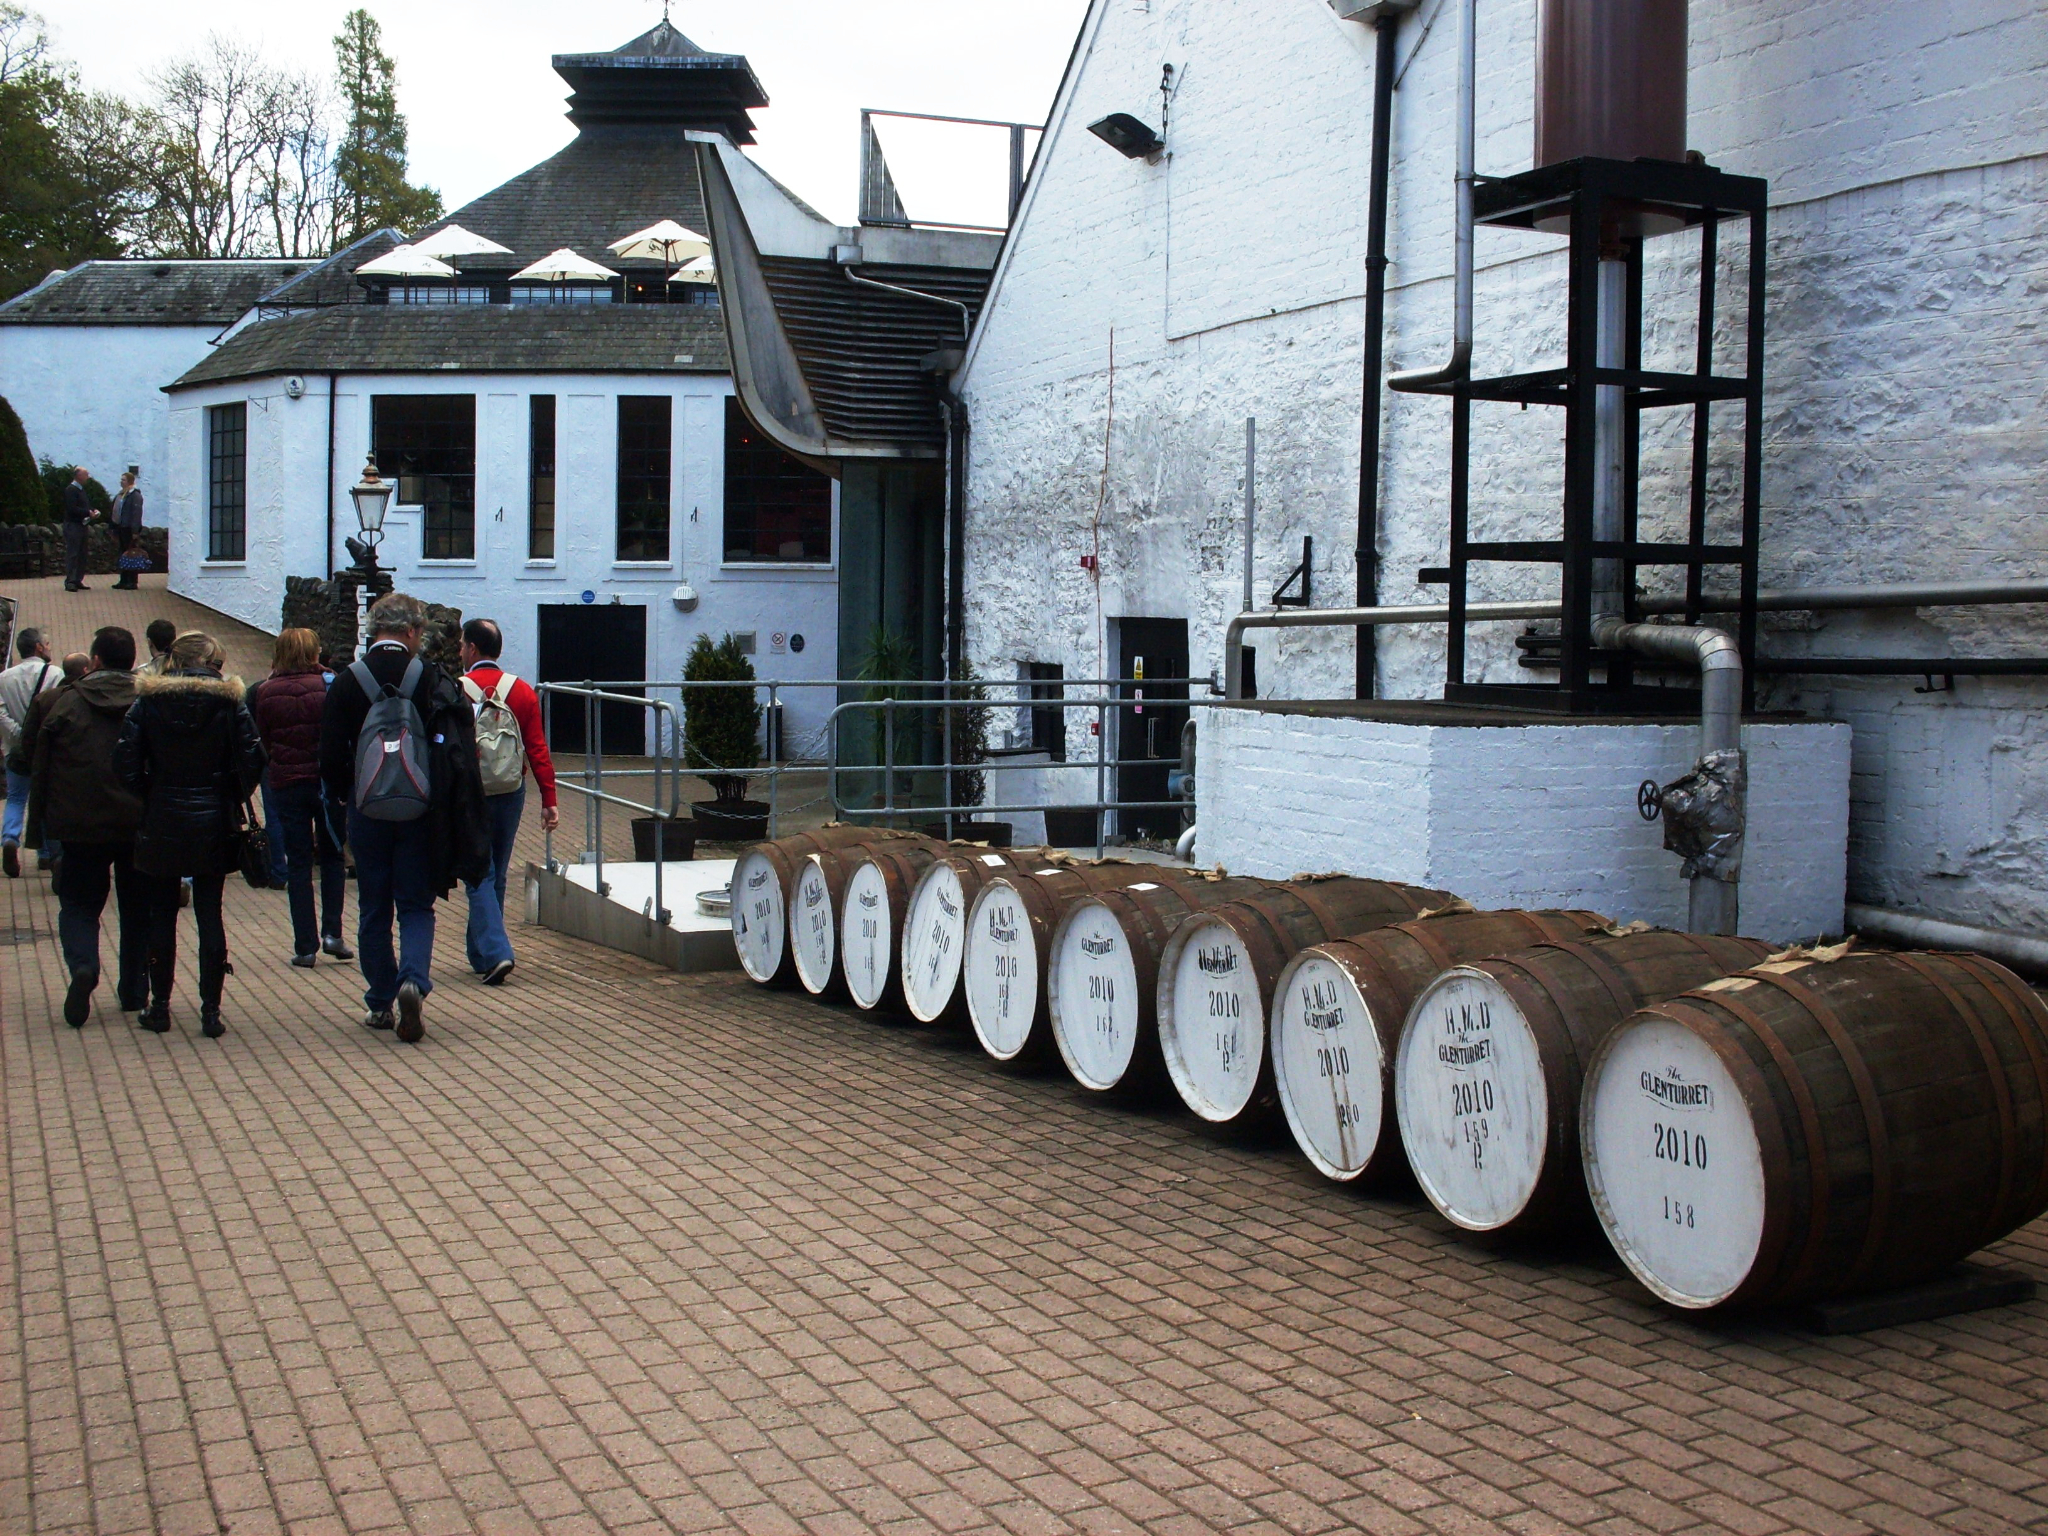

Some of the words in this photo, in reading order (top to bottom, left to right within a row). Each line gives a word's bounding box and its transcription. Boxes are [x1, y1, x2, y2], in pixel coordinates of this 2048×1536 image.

[755, 898, 771, 920] 2010
[812, 910, 827, 933] 2010
[862, 918, 877, 938] 2010
[931, 919, 950, 954] 2010
[1081, 938, 1114, 955] GLENTURRET
[995, 955, 1017, 978] 2010
[1089, 975, 1114, 1003] 2010
[1209, 990, 1239, 1018] 2010
[1318, 1047, 1349, 1077] 2010
[1439, 1039, 1491, 1066] GLENTURRET
[1666, 1065, 1685, 1082] The
[1452, 1079, 1494, 1116] 2010
[1640, 1071, 1709, 1105] GLENTURRET
[1464, 1118, 1489, 1143] 159
[1654, 1122, 1707, 1170] 2010
[1664, 1195, 1695, 1229] 158
